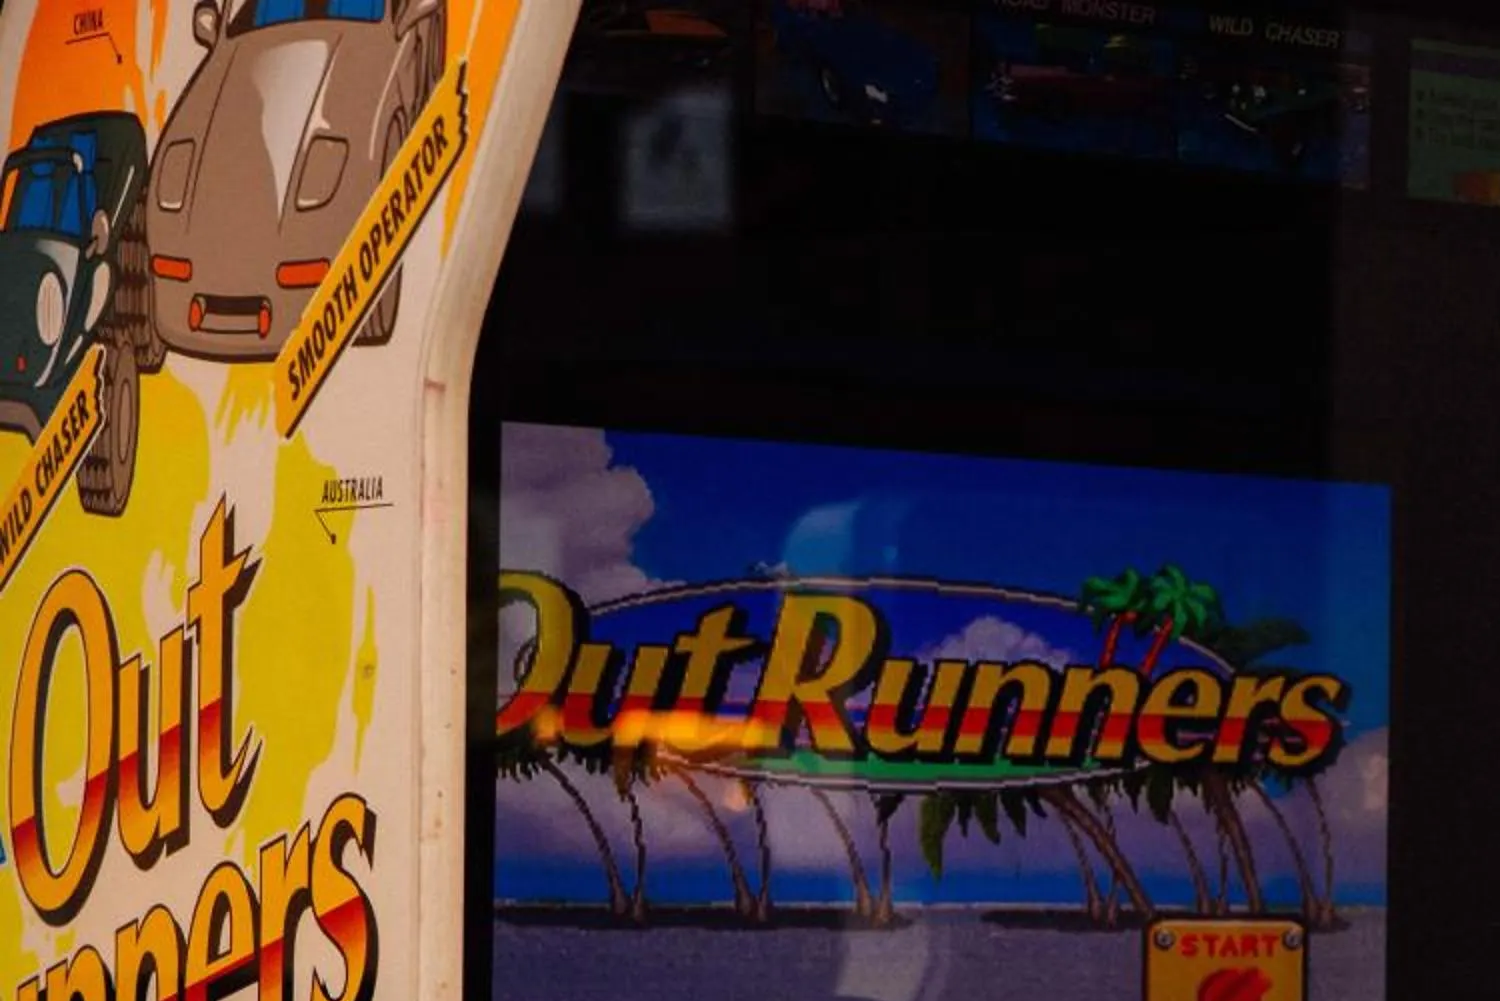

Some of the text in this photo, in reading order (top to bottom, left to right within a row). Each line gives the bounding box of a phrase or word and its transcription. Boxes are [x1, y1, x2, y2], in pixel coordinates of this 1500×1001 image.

[73, 8, 103, 35] CHINA
[1209, 14, 1341, 49] WILD CHASER
[287, 114, 450, 402] SMOOTH OPERATOR
[34, 389, 90, 497] CHASER
[321, 476, 383, 503] AUSTRALIA
[11, 492, 262, 926] Out
[1180, 932, 1280, 959] START
